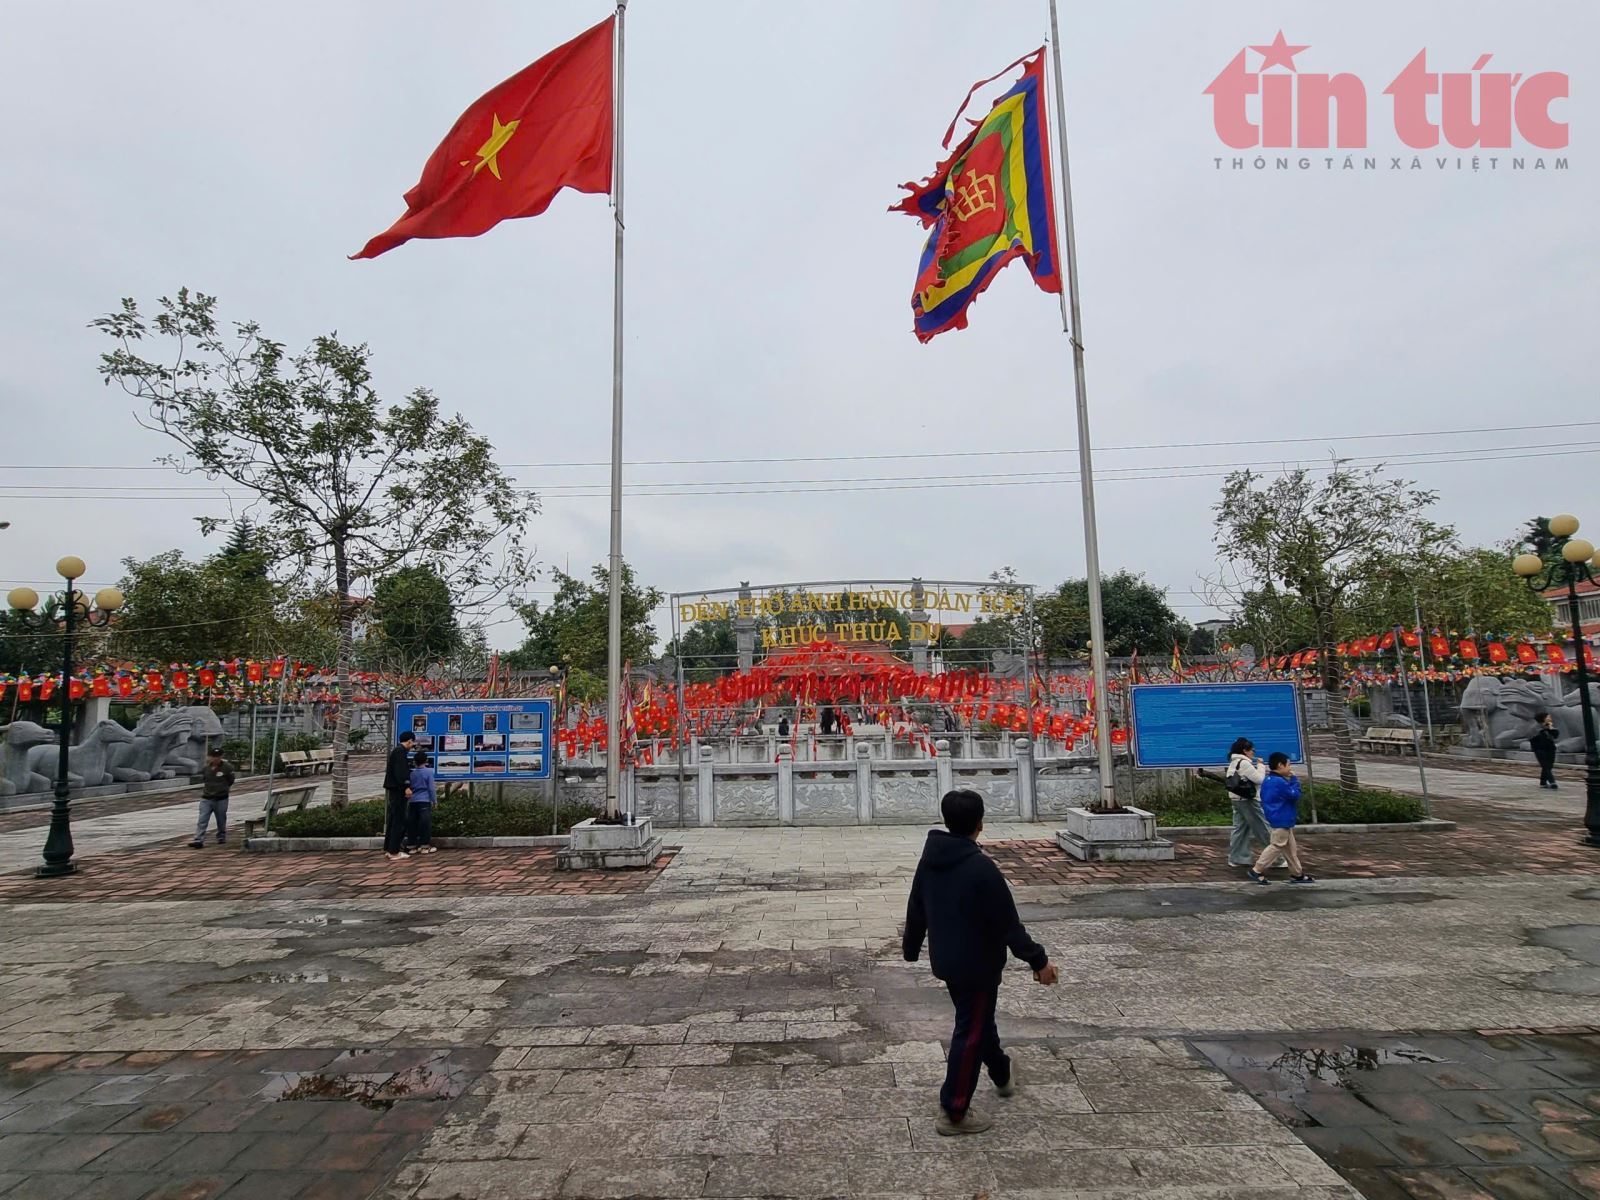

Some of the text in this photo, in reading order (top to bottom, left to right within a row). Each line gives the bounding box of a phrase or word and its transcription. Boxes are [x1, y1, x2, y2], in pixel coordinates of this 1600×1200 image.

[680, 593, 729, 622] ĐỀN
[733, 589, 784, 617] THỜ
[790, 592, 845, 612] ANH
[848, 584, 918, 611] HÙNG
[923, 587, 973, 612] DÂN
[760, 620, 827, 648] KHÚC
[834, 617, 901, 641] THỪA
